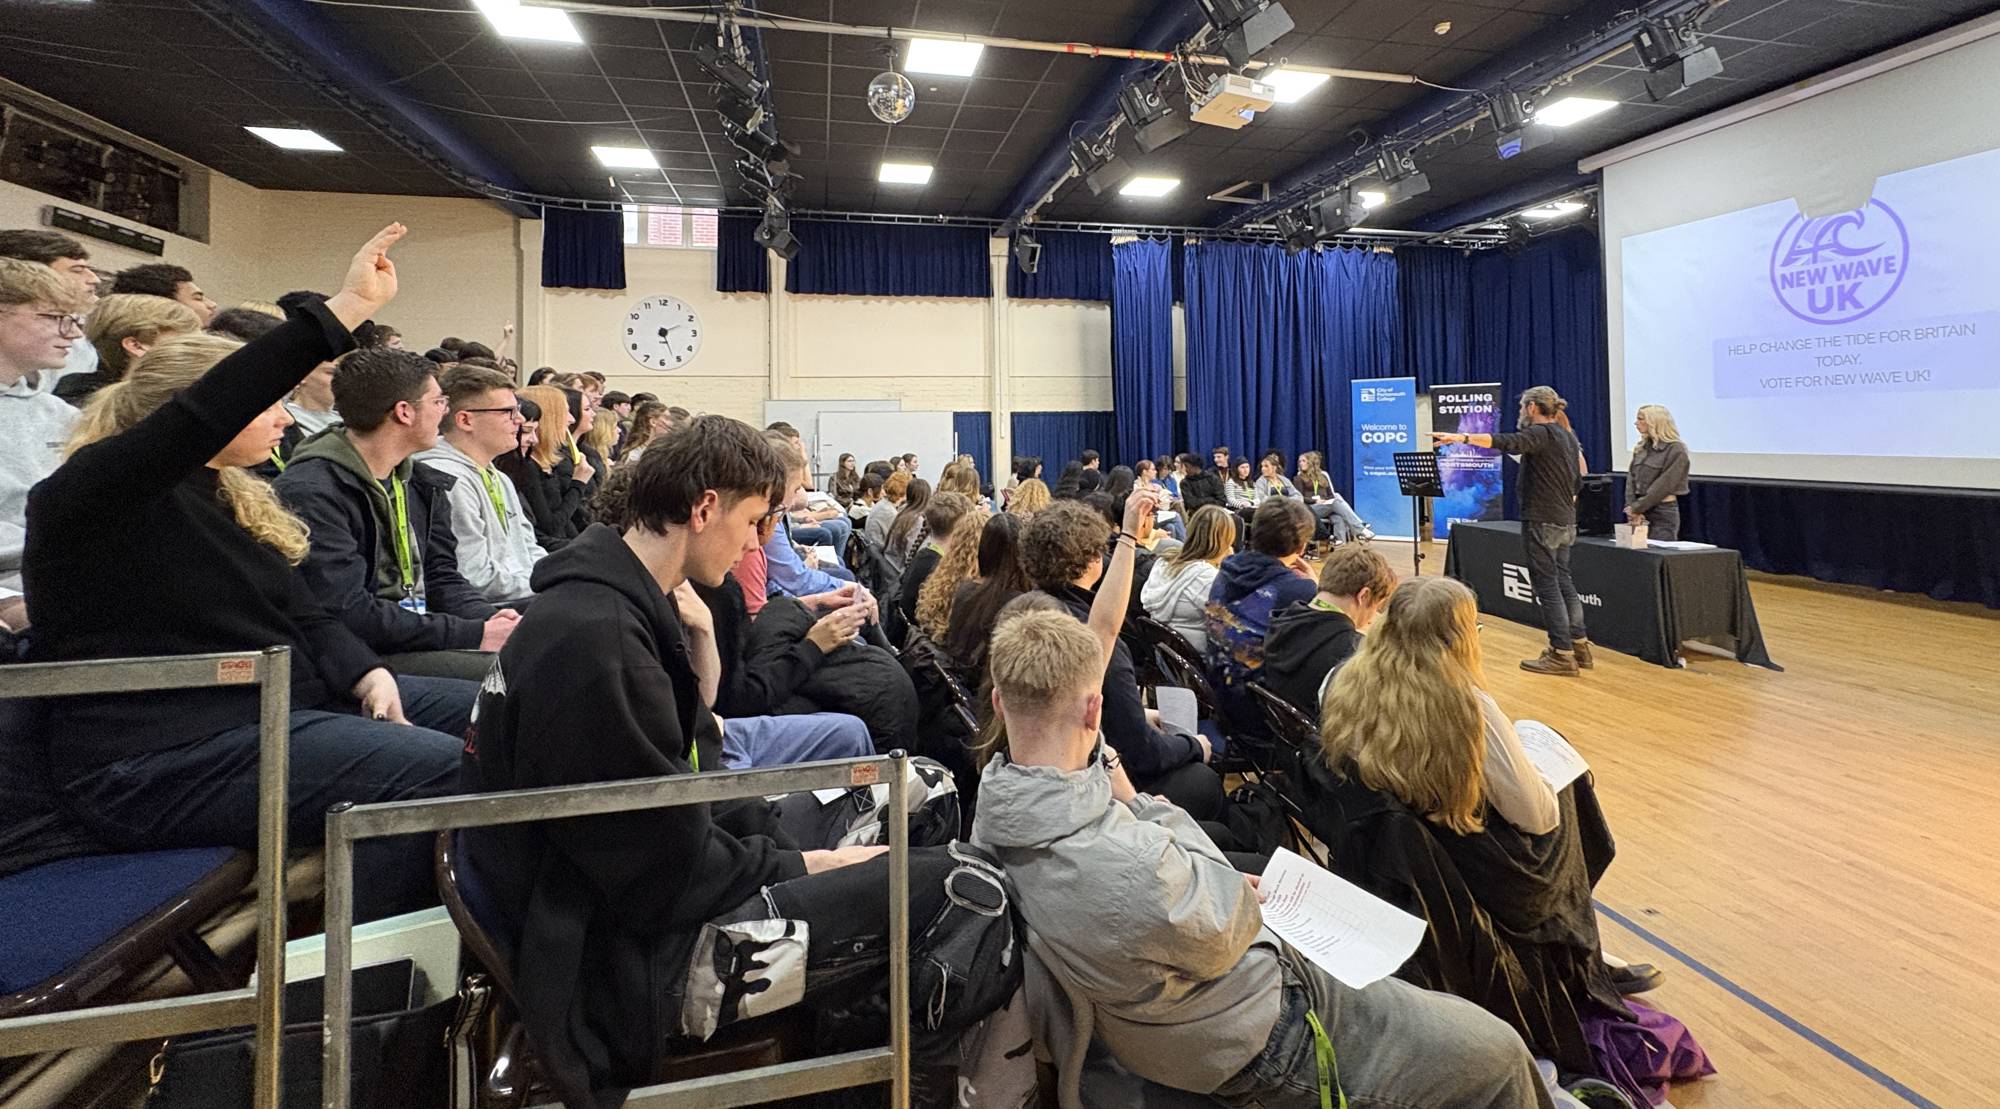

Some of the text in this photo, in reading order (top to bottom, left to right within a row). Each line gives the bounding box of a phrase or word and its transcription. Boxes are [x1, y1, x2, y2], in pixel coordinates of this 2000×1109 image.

[1780, 255, 1897, 290] NEW WAVE
[659, 299, 668, 307] 12
[1807, 281, 1865, 315] UK
[691, 329, 697, 337] 3
[1727, 323, 1976, 356] HELP CHANGE THE TIDE FOR BRITAIN
[1814, 353, 1863, 368] TODAY.
[1759, 369, 1931, 389] VOTE FOR NEW WAVE UK!
[1438, 393, 1493, 403] POLLING
[1438, 404, 1493, 414] STATION
[1361, 423, 1407, 431] Welcome to
[1361, 431, 1408, 444] COPC
